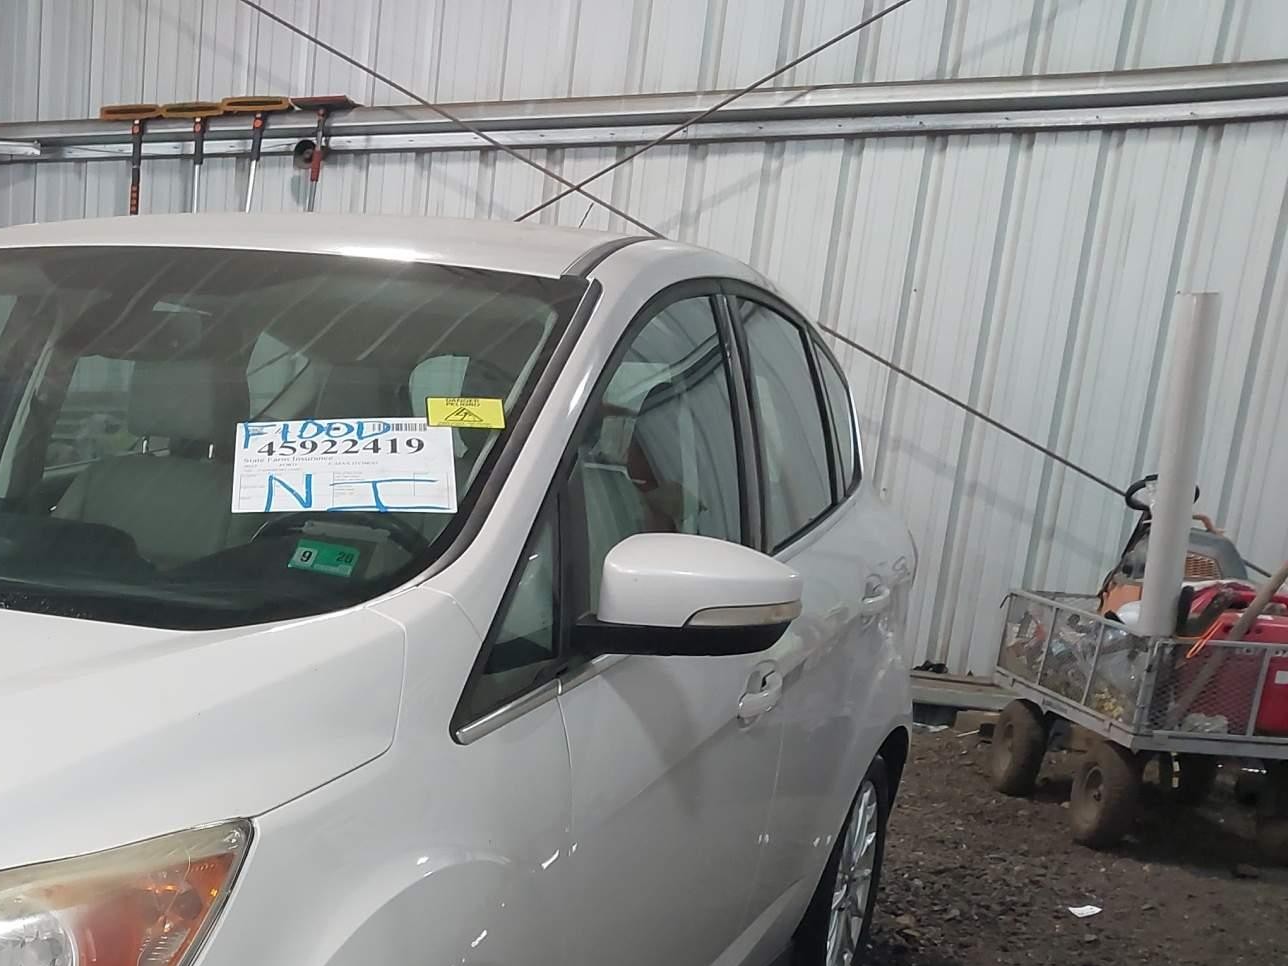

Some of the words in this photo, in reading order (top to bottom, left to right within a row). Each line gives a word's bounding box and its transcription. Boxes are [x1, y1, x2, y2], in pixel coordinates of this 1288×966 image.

[257, 437, 425, 457] 45922419
[265, 473, 313, 512] N
[300, 550, 313, 562] 9
